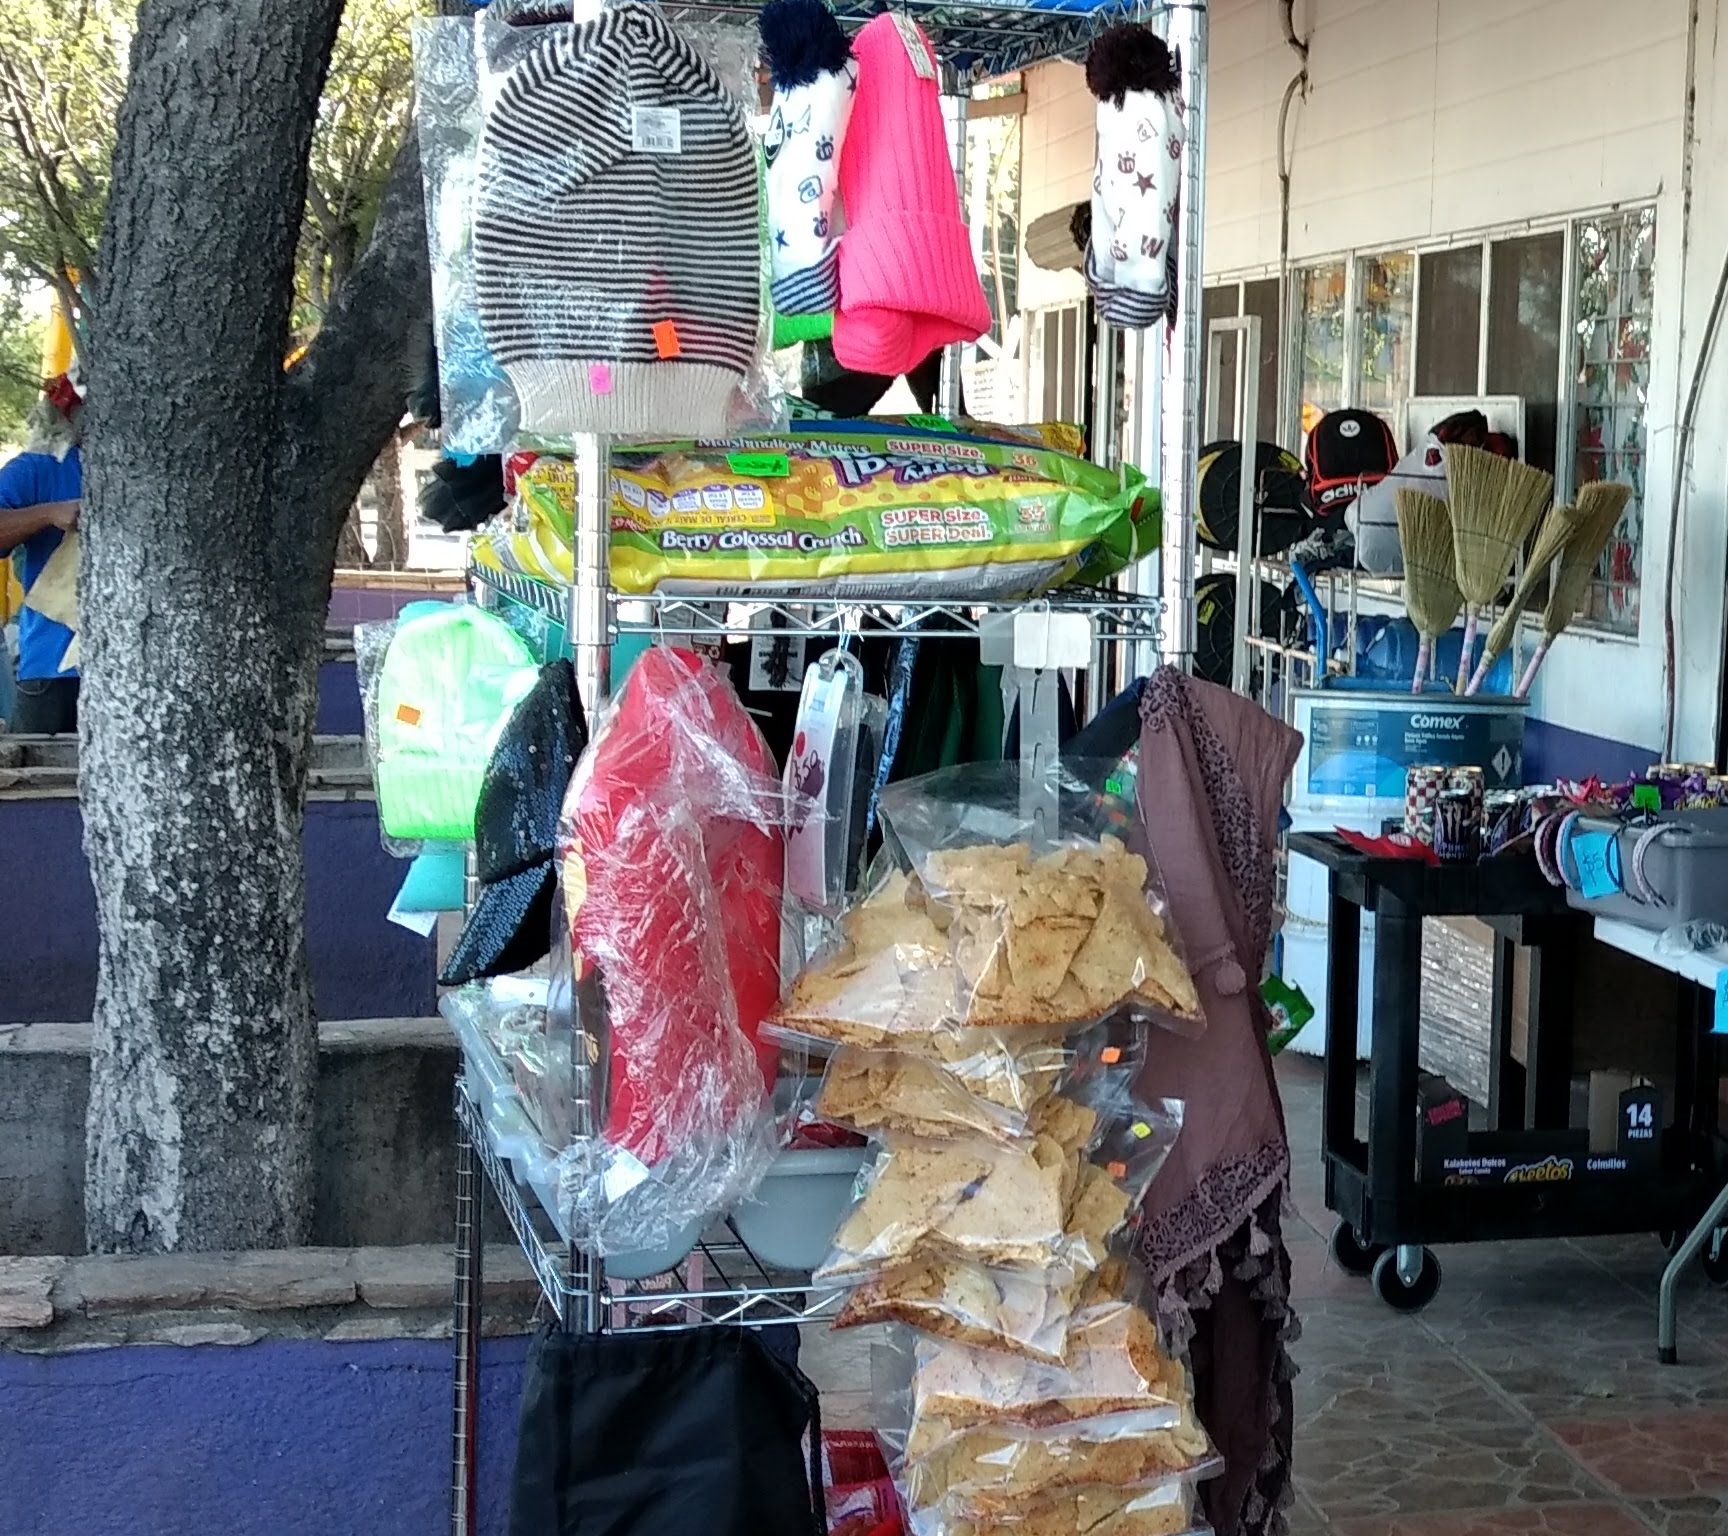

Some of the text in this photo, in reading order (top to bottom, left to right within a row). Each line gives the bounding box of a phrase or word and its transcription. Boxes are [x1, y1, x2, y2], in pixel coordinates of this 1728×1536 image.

[697, 437, 805, 452] Marshmallow
[888, 439, 945, 456] SUPER
[882, 508, 987, 525] SUPER Size.
[662, 529, 865, 549] Berry Colossal Crunch
[885, 526, 947, 545] SUPER
[948, 526, 992, 543] Deal.
[1410, 713, 1465, 730] Comex
[1626, 1102, 1653, 1128] 14
[1627, 1128, 1654, 1139] PIEZAS
